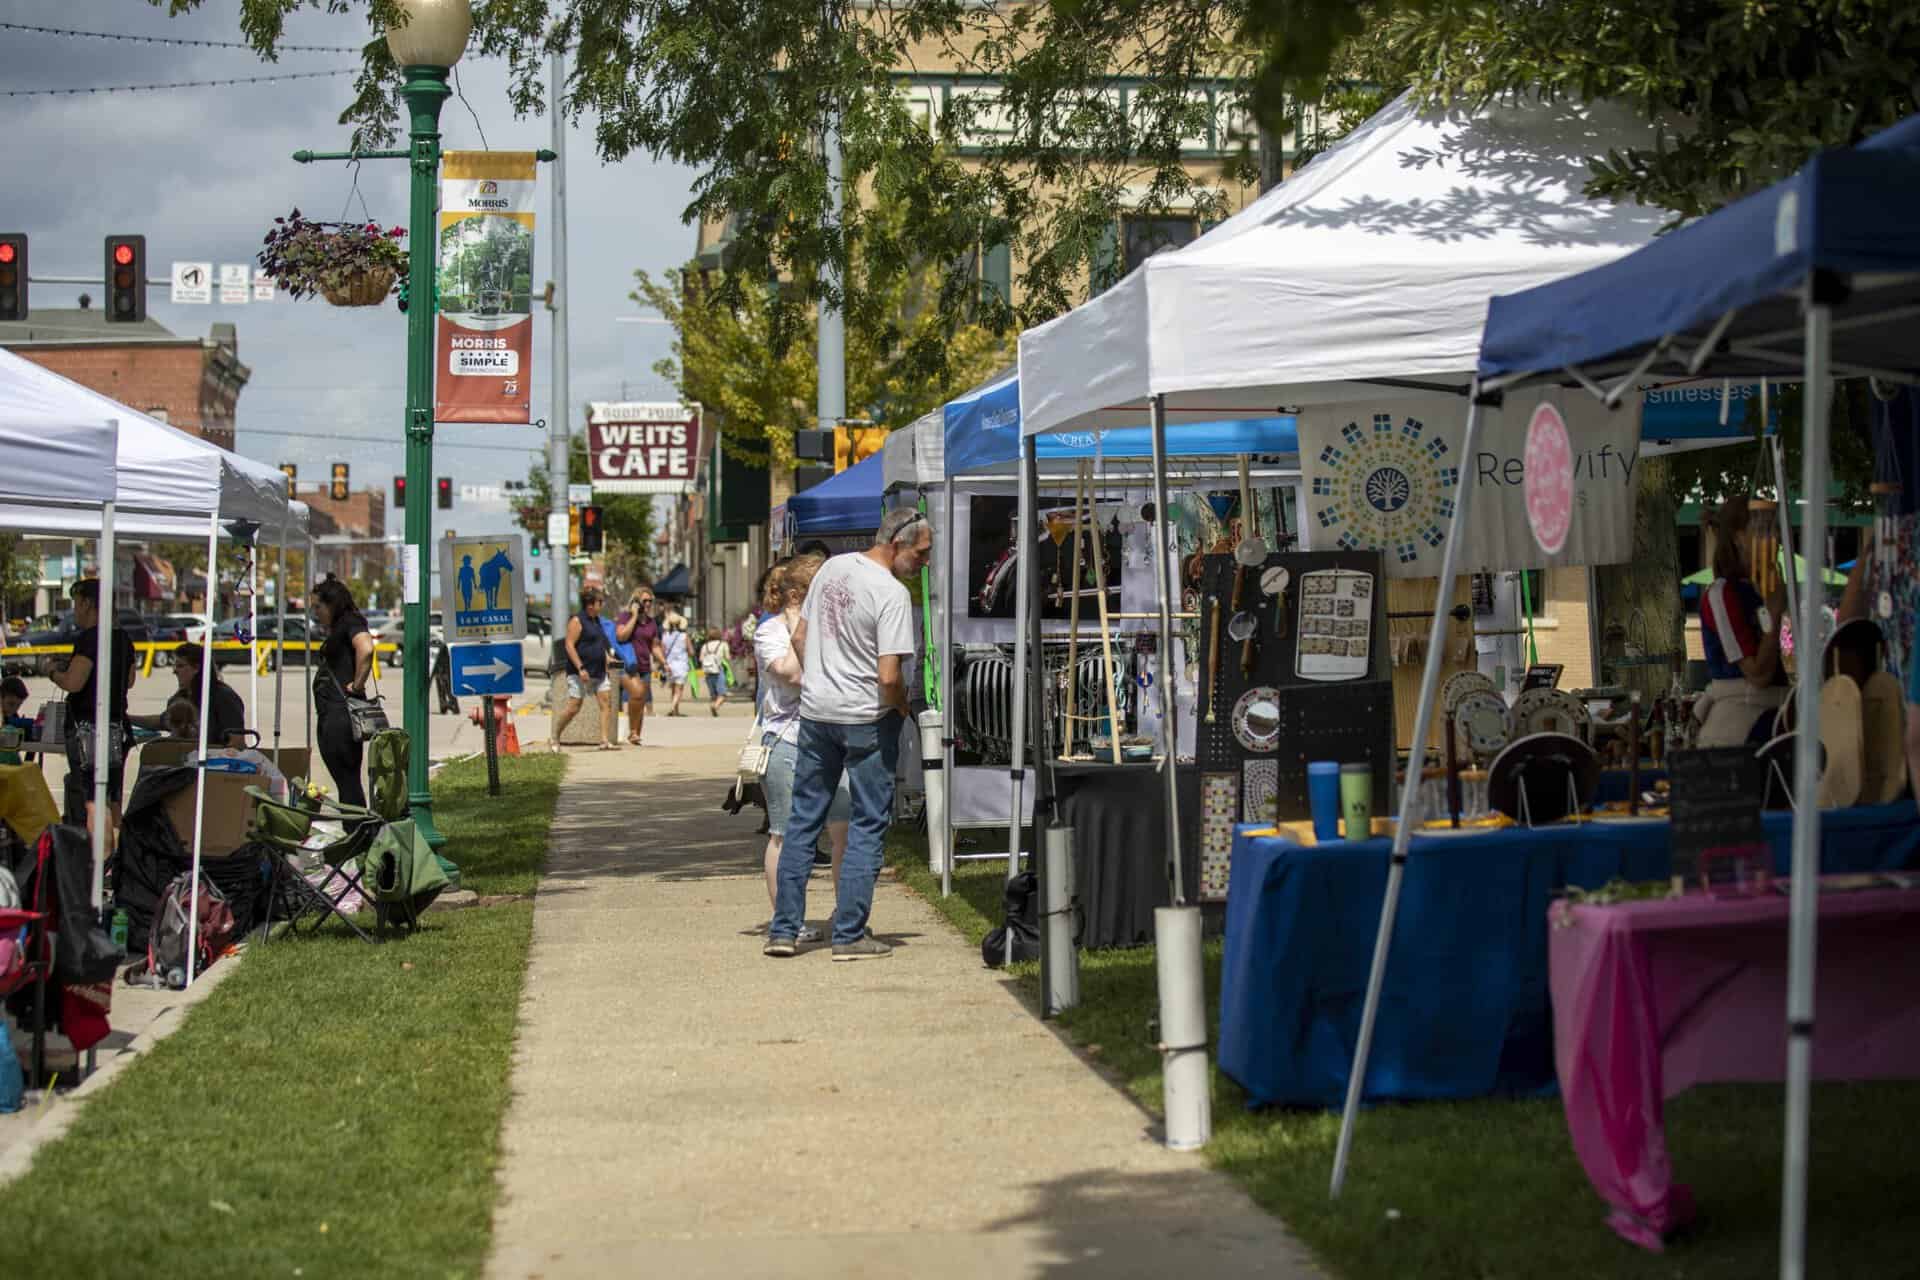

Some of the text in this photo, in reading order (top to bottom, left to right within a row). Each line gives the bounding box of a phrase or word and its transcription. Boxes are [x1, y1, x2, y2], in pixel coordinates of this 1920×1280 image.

[468, 199, 509, 208] MORRIS
[451, 338, 507, 349] MORRIS
[460, 358, 509, 367] SIMPLE
[599, 425, 687, 446] WEITS
[599, 447, 689, 477] CAFE
[482, 615, 509, 623] CANAL
